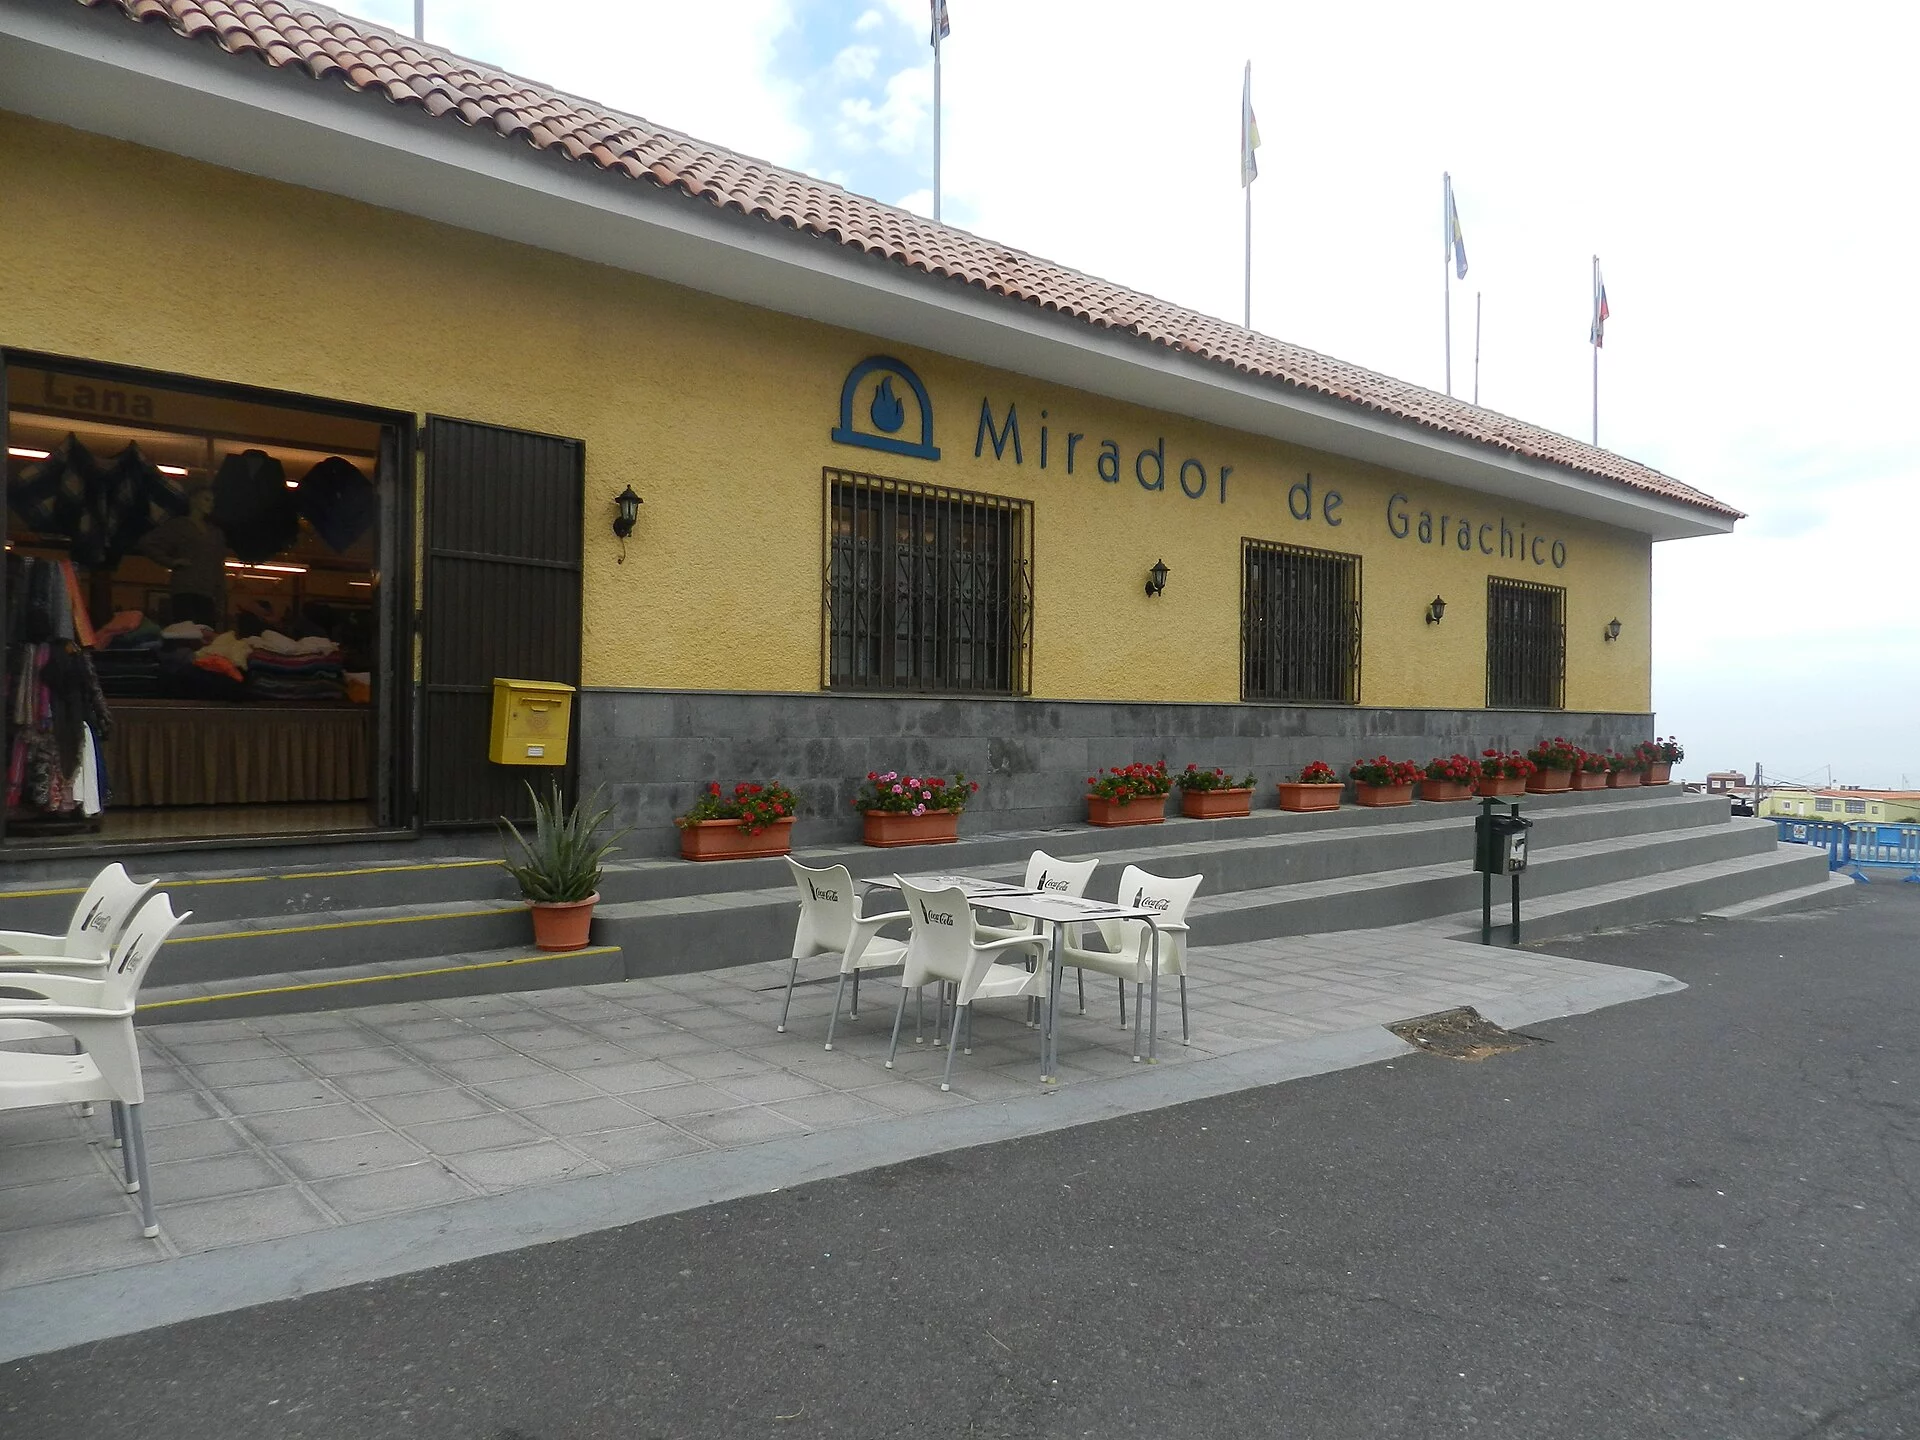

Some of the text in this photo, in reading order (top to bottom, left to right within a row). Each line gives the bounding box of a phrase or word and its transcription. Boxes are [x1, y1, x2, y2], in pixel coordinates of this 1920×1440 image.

[43, 371, 153, 419] Lana
[974, 396, 1566, 569] Mirador de Garachico
